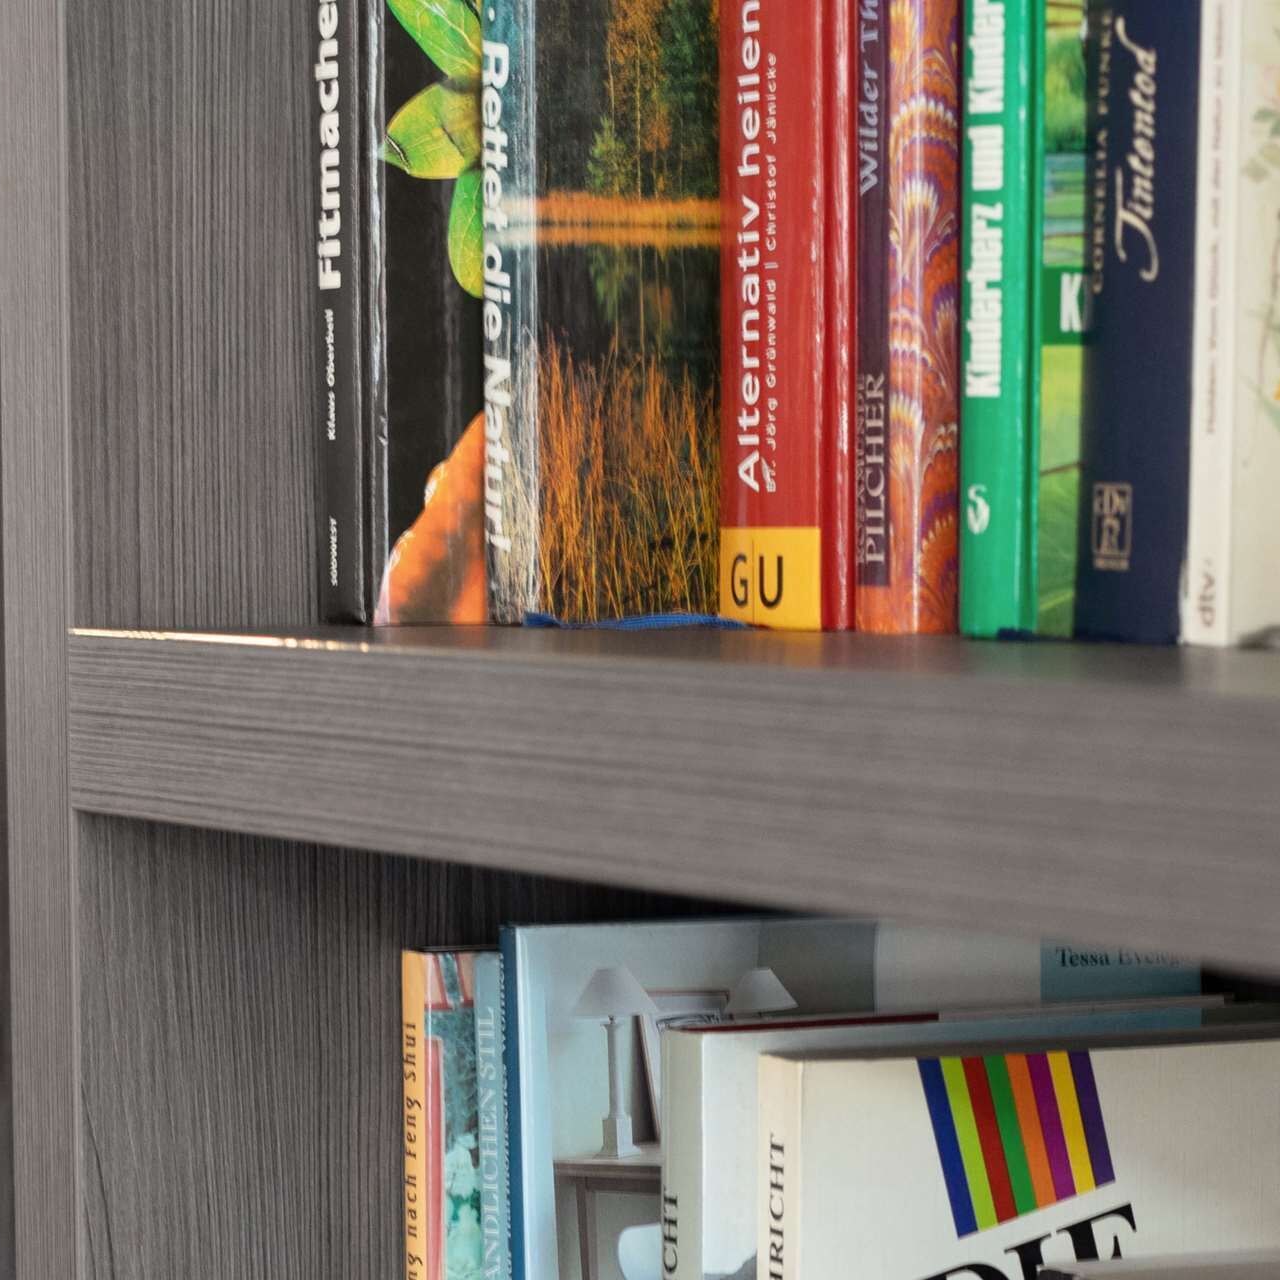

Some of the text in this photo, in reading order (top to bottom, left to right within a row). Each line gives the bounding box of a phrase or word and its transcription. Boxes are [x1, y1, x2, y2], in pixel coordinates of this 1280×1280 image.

[316, 0, 341, 289] Fitmache
[761, 52, 777, 144] Jänicke
[858, 60, 879, 197] Wilder
[969, 124, 1004, 192] und
[1092, 8, 1112, 294] CORNELIA FUNKE
[1114, 15, 1160, 283] Tintentod
[736, 0, 761, 493] Alternativ heilen
[762, 154, 777, 251] Christof
[482, 39, 512, 555] Rettet die Natur!
[763, 279, 778, 388] Grünwald
[965, 203, 1004, 397] Kinderherz
[325, 391, 337, 441] Klaus
[763, 397, 780, 450] Jörg
[864, 372, 885, 564] PILCHER
[1197, 564, 1218, 628] dtv
[1055, 945, 1111, 969] Tessa
[404, 1021, 418, 1083] Shui
[477, 1006, 497, 1081] STIL
[405, 1174, 418, 1238] nach
